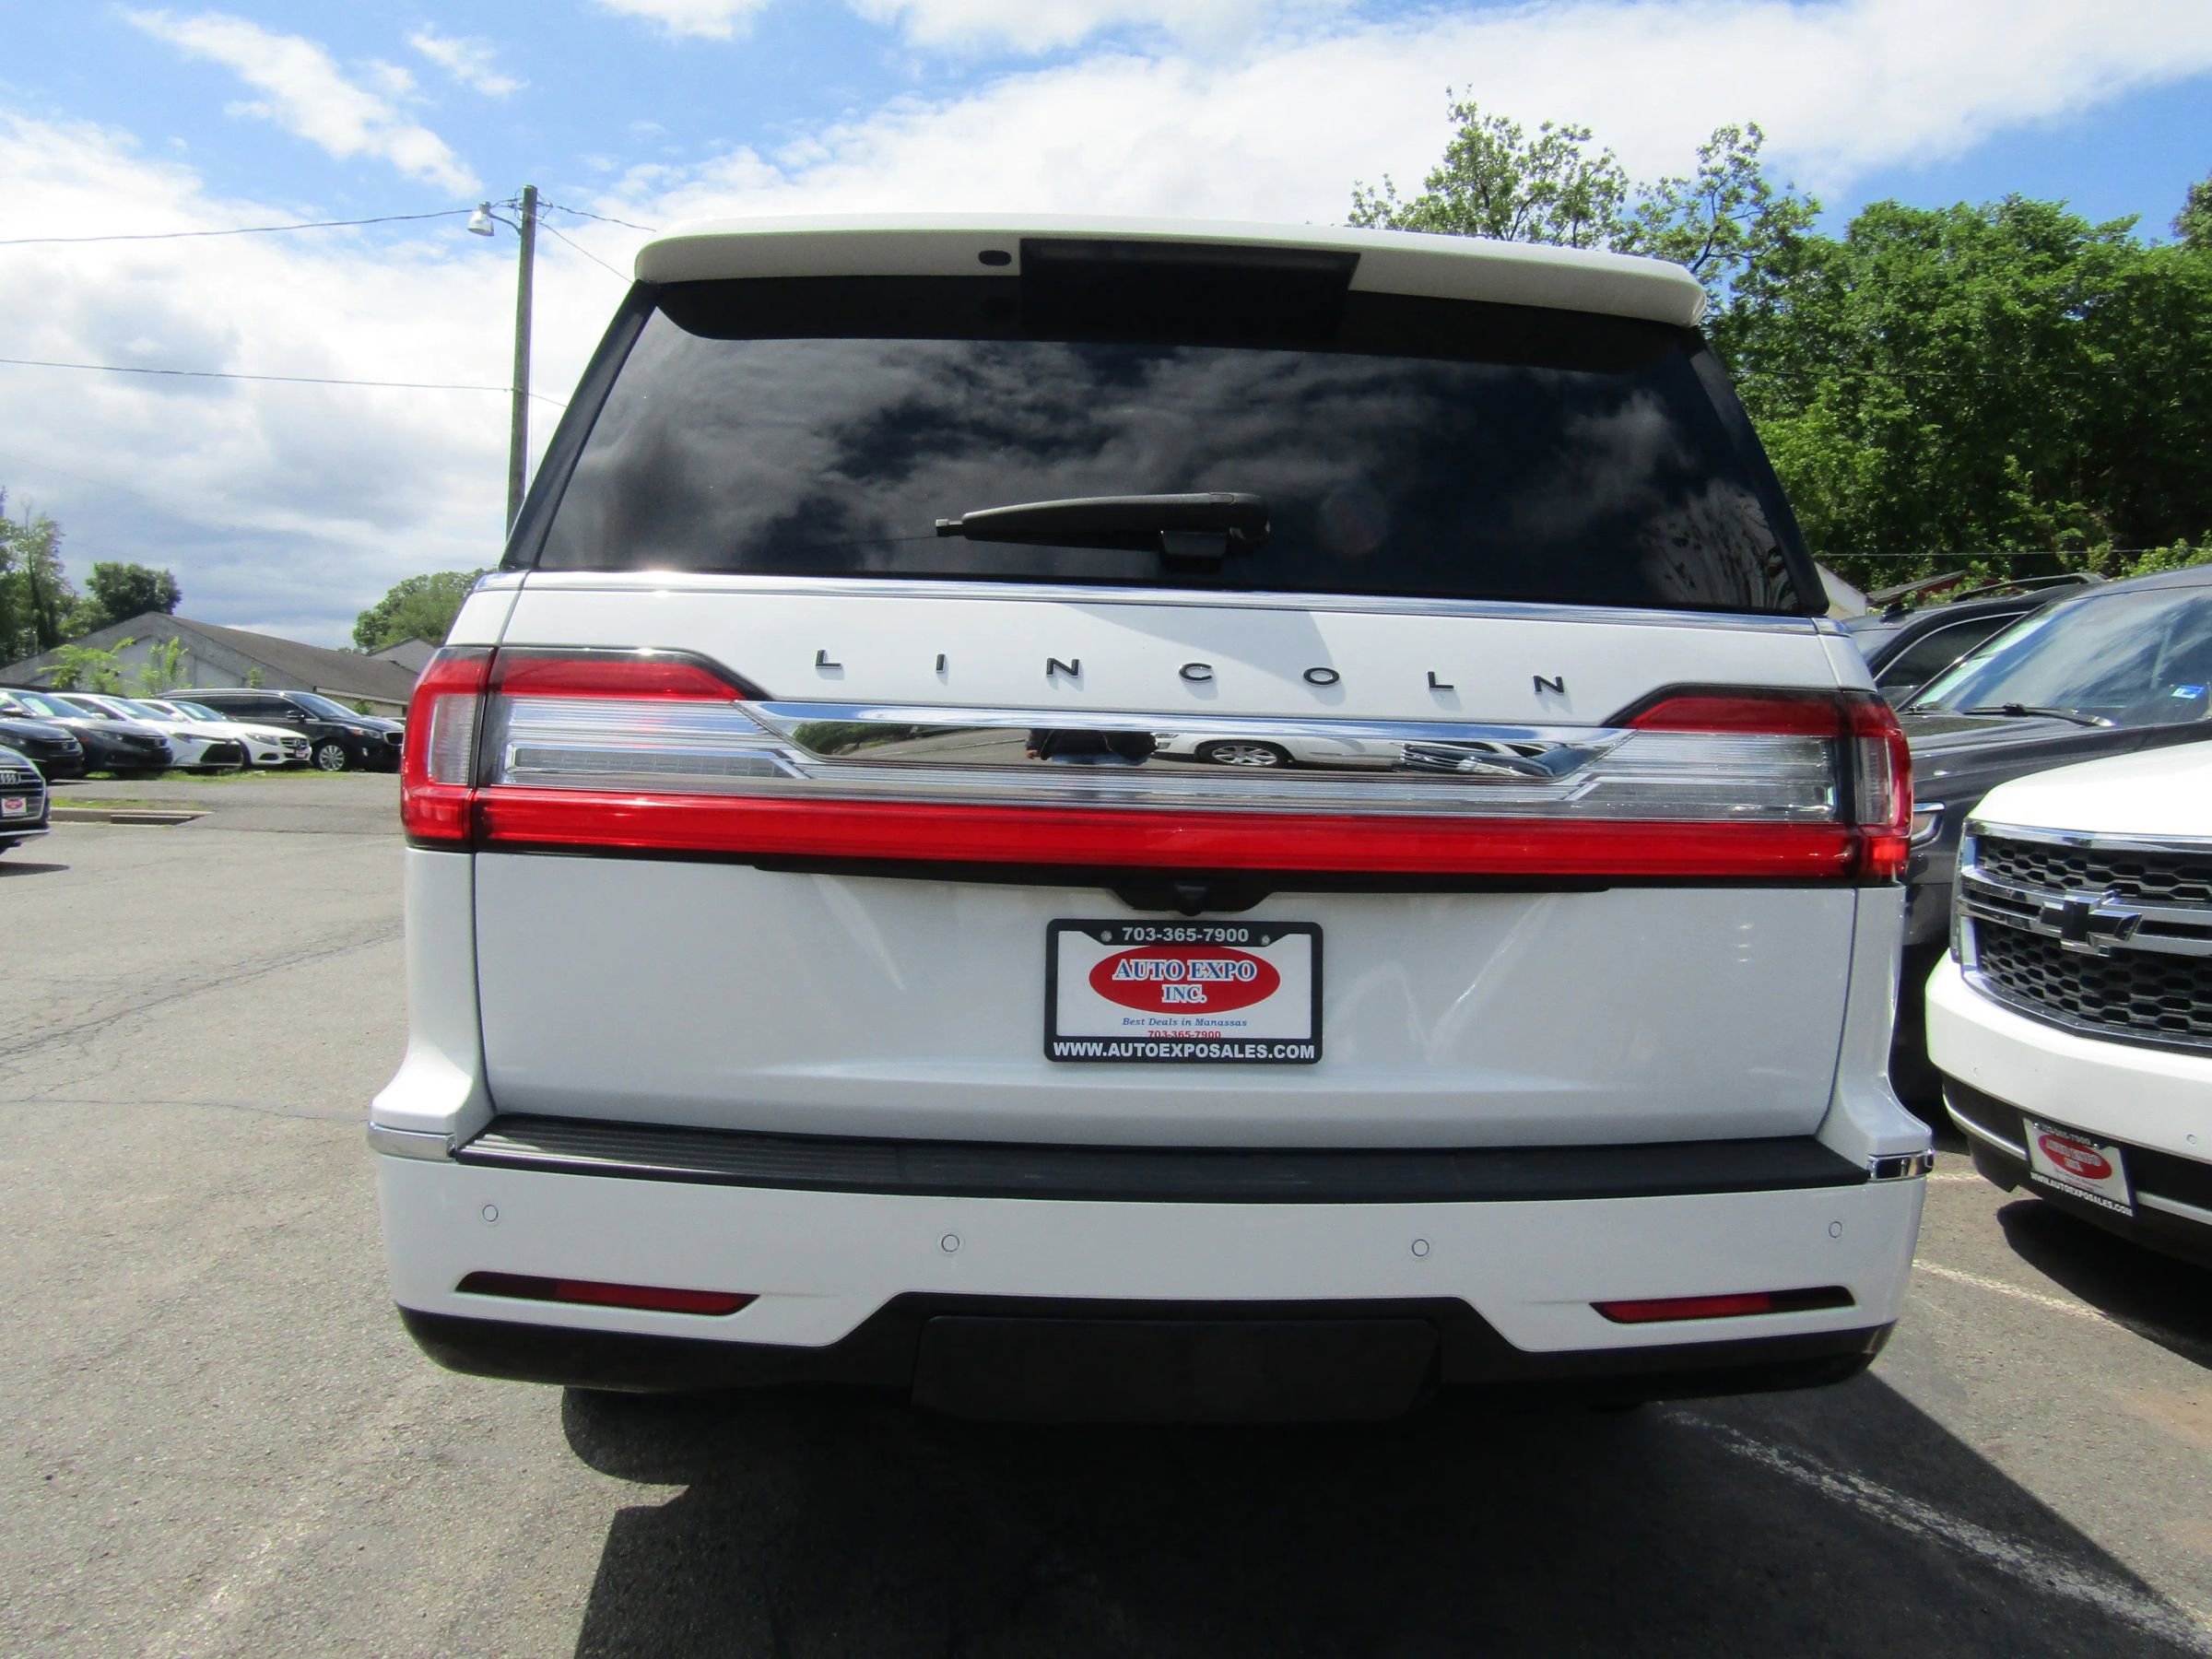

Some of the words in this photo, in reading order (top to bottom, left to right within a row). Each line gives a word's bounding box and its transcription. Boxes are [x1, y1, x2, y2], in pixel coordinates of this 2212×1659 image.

[816, 649, 1565, 695] LINCOLN
[1122, 926, 1249, 942] 703-365-7900
[1112, 959, 1184, 981] AUTO
[1187, 959, 1257, 982] EXPO
[1162, 984, 1207, 1004] INC.
[1122, 1018, 1146, 1026] Best
[1148, 1018, 1178, 1026] Deals
[1181, 1018, 1192, 1026] in
[1194, 1018, 1248, 1027] Manassas
[1147, 1030, 1221, 1039] 703-365-7900
[1053, 1041, 1315, 1059] WWW.AUTOEXPOSALES.COM
[2030, 1171, 2134, 1218] WWW.AUTOEXPOSALES.COM
